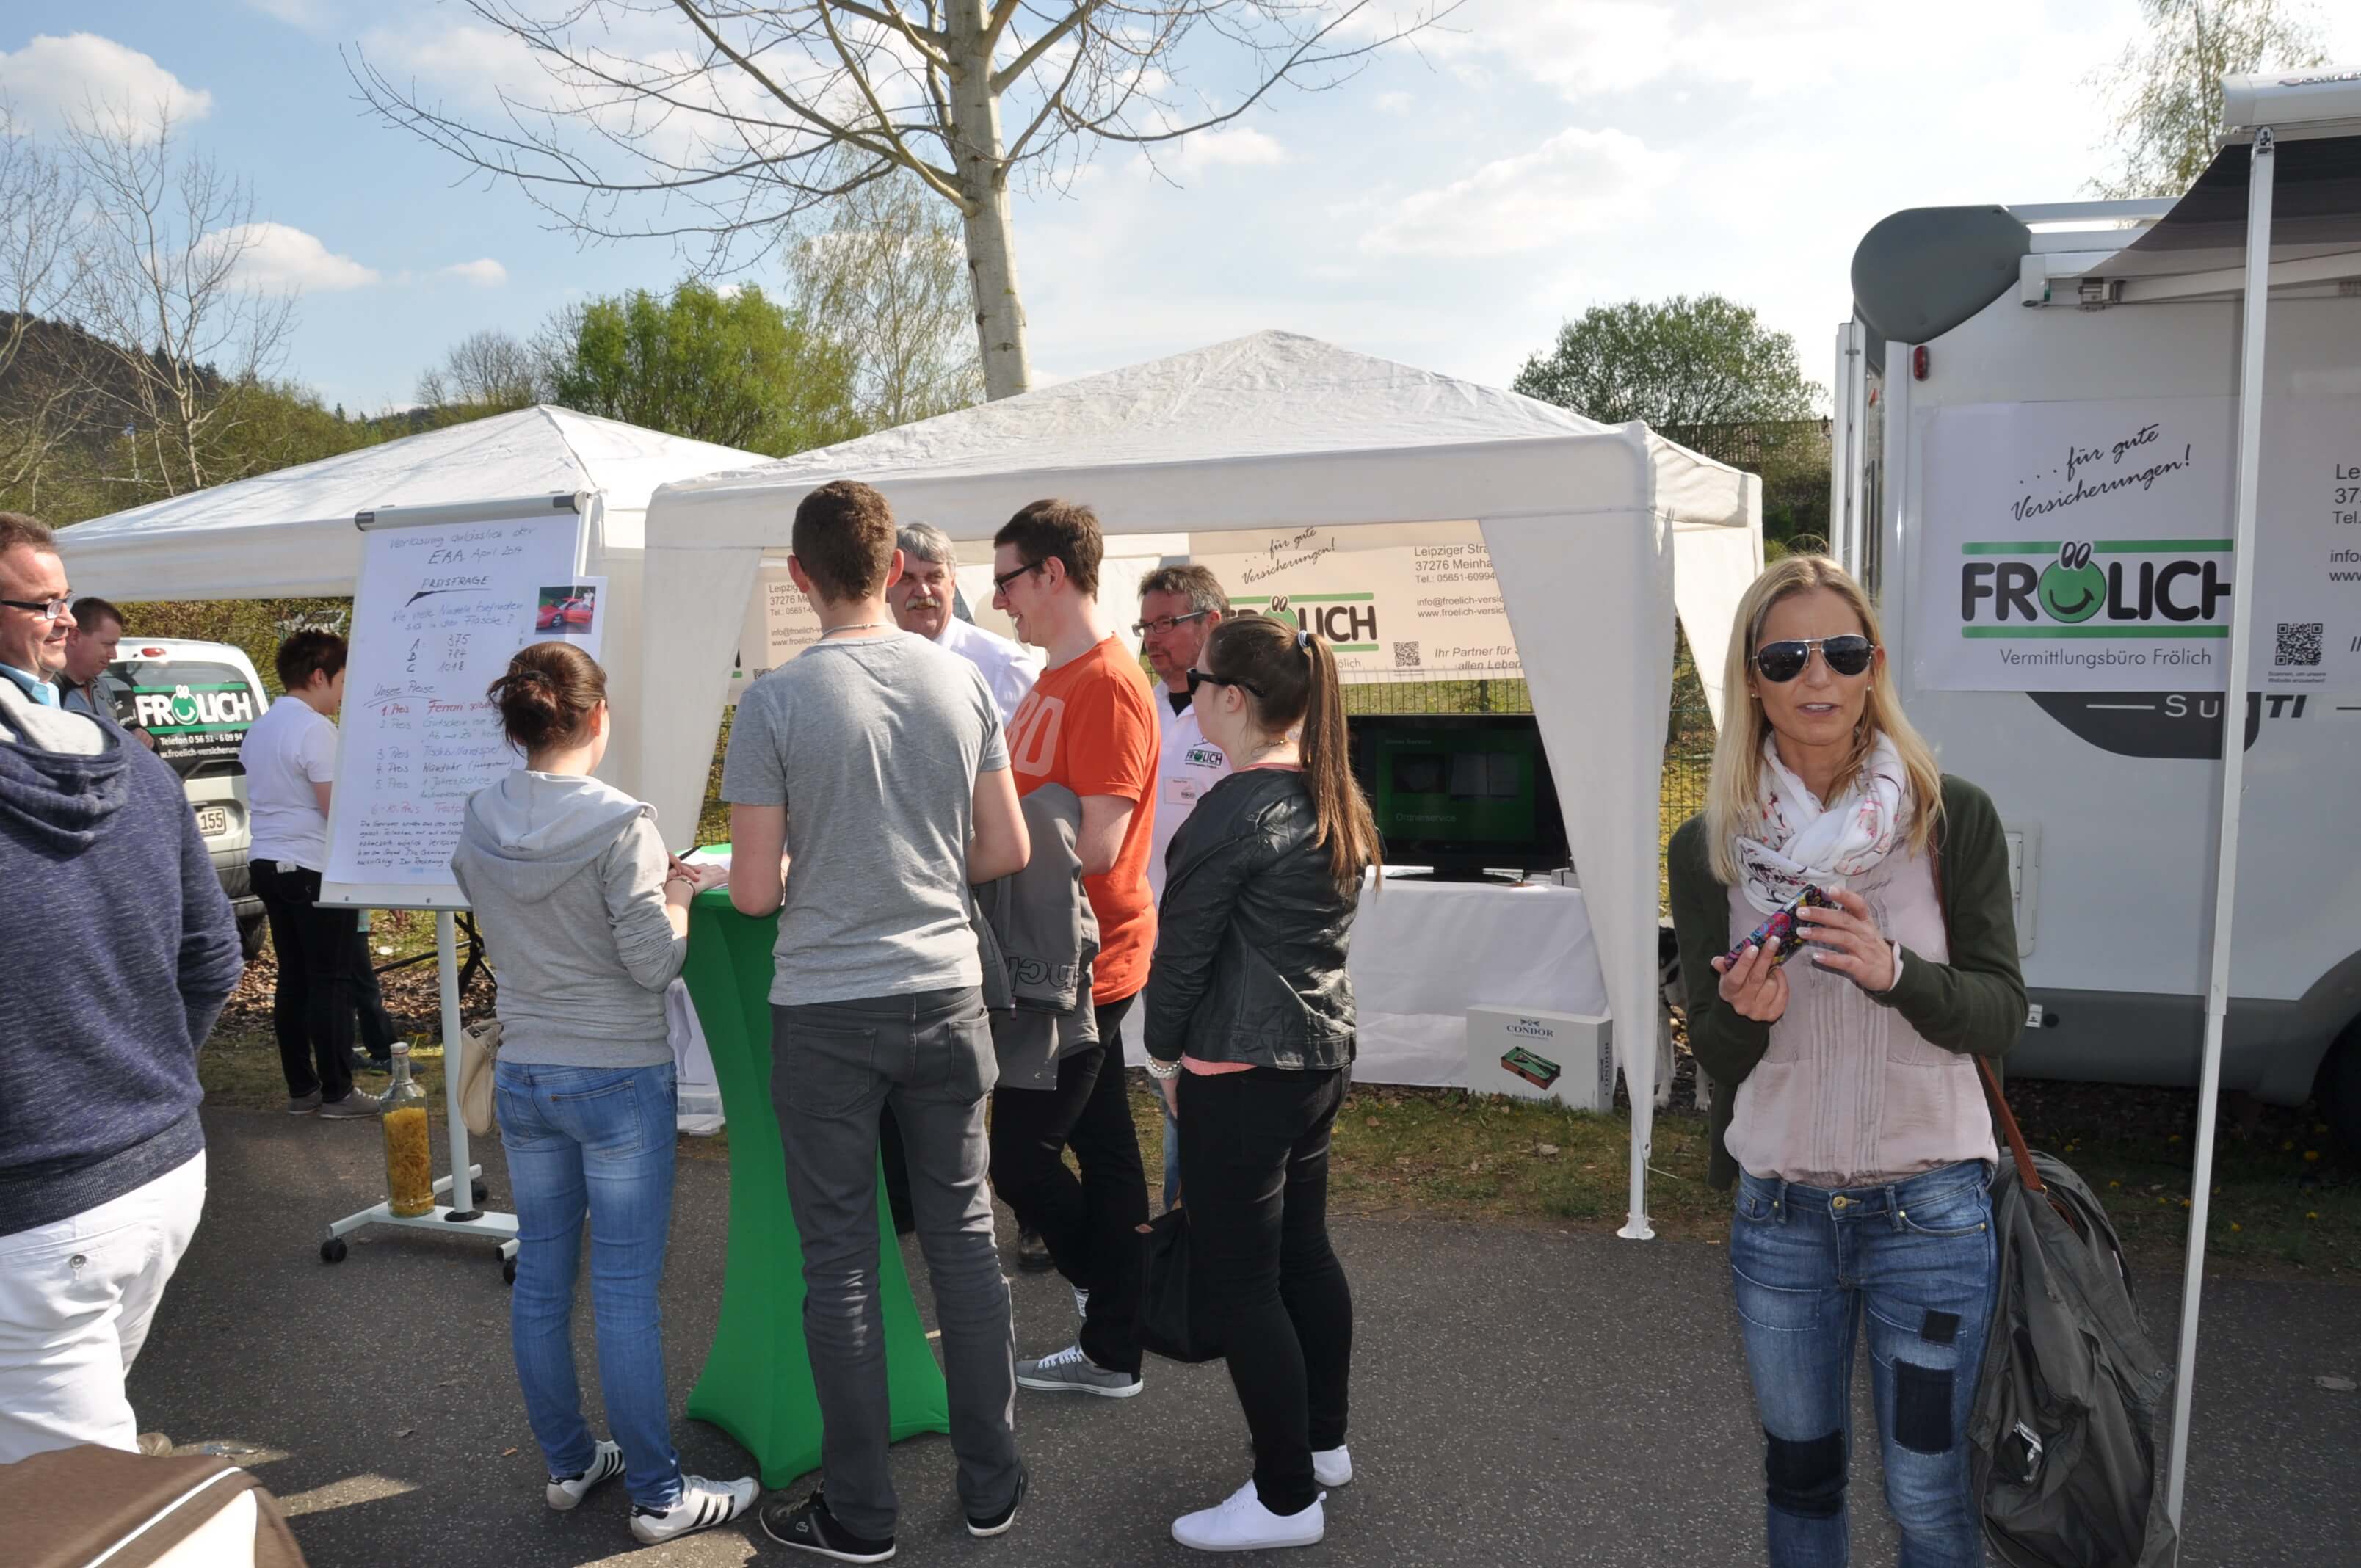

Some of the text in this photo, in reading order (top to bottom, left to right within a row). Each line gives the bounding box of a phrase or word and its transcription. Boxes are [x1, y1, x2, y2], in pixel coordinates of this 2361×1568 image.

[2066, 446, 2104, 482] für
[2112, 423, 2160, 464] gute
[2010, 443, 2191, 521] Versicherungen!
[2334, 487, 2361, 504] 37
[1294, 526, 1316, 550] gute
[428, 549, 465, 564] EAA
[1414, 544, 1464, 558] Leipziger
[2329, 548, 2361, 563] info
[1241, 537, 1336, 584] Versicherungen!
[1415, 558, 1493, 571] 37276 Meinha
[769, 595, 796, 606] 37276
[447, 634, 471, 647] 375
[407, 651, 416, 662] B
[1435, 645, 1511, 658] Ihr Partner für
[1999, 647, 2212, 669] Vermittlungsbüro Frölich
[406, 663, 416, 672] C
[135, 684, 253, 726] FRÖLICH
[2266, 694, 2307, 719] TI
[159, 736, 188, 746] Telefon
[200, 812, 223, 830] 155
[1506, 1024, 1554, 1037] CONDOR
